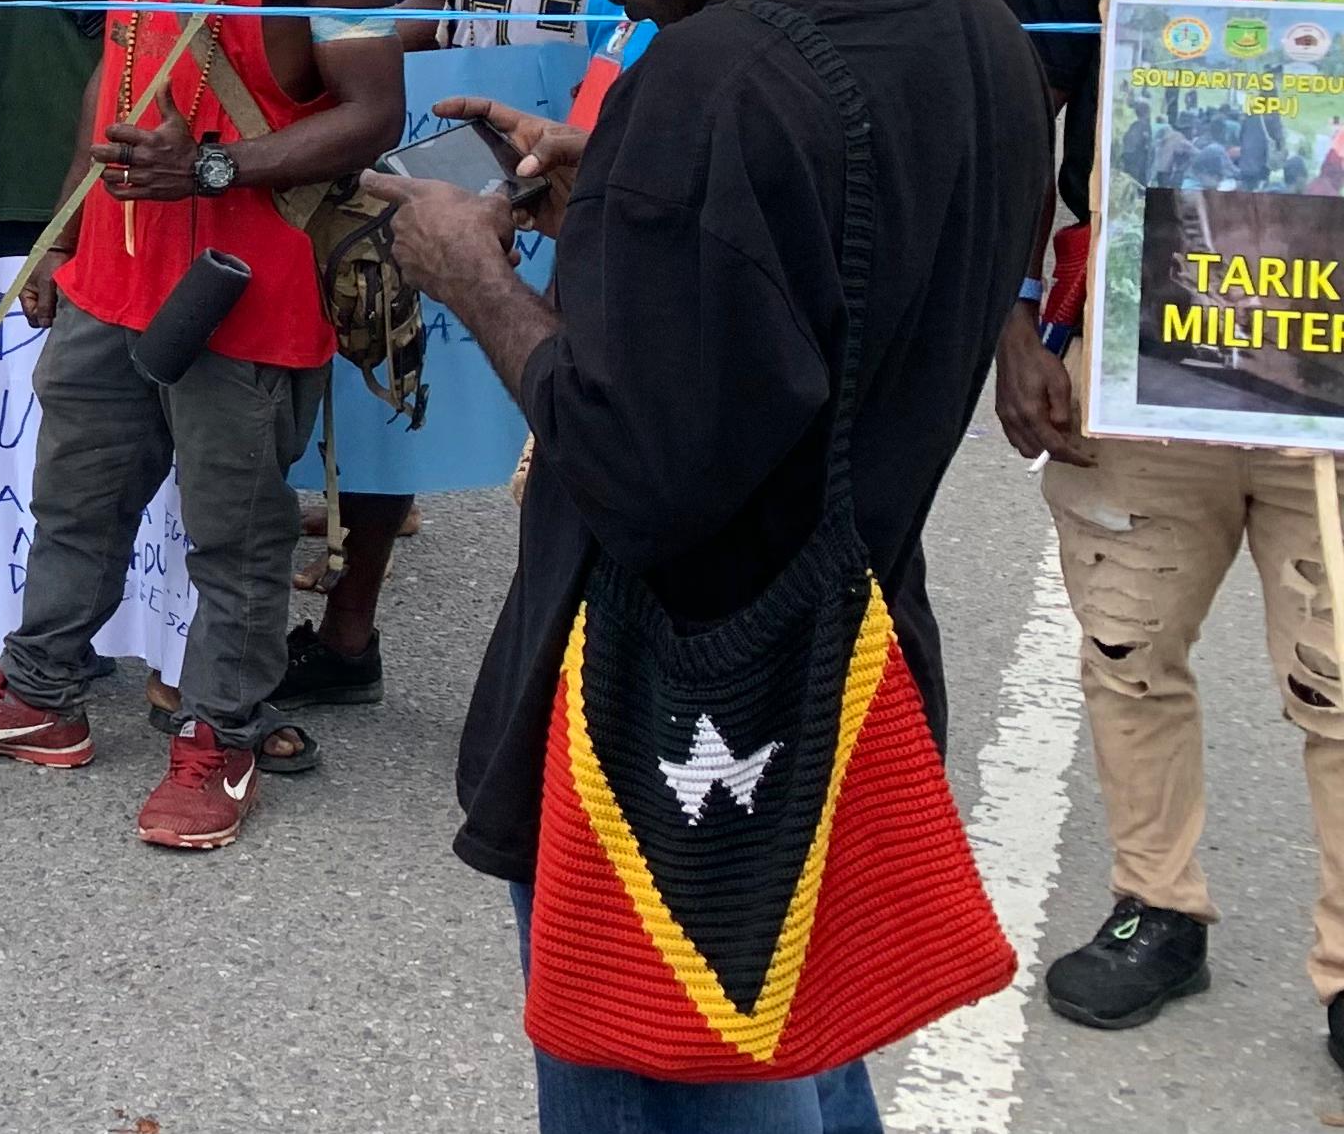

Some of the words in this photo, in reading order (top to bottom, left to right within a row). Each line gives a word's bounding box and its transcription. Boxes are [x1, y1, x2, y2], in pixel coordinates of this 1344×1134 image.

[1131, 68, 1275, 92] SOLIDARITAS
[1244, 96, 1300, 117] (SPJ)
[1185, 253, 1342, 301] TARIK
